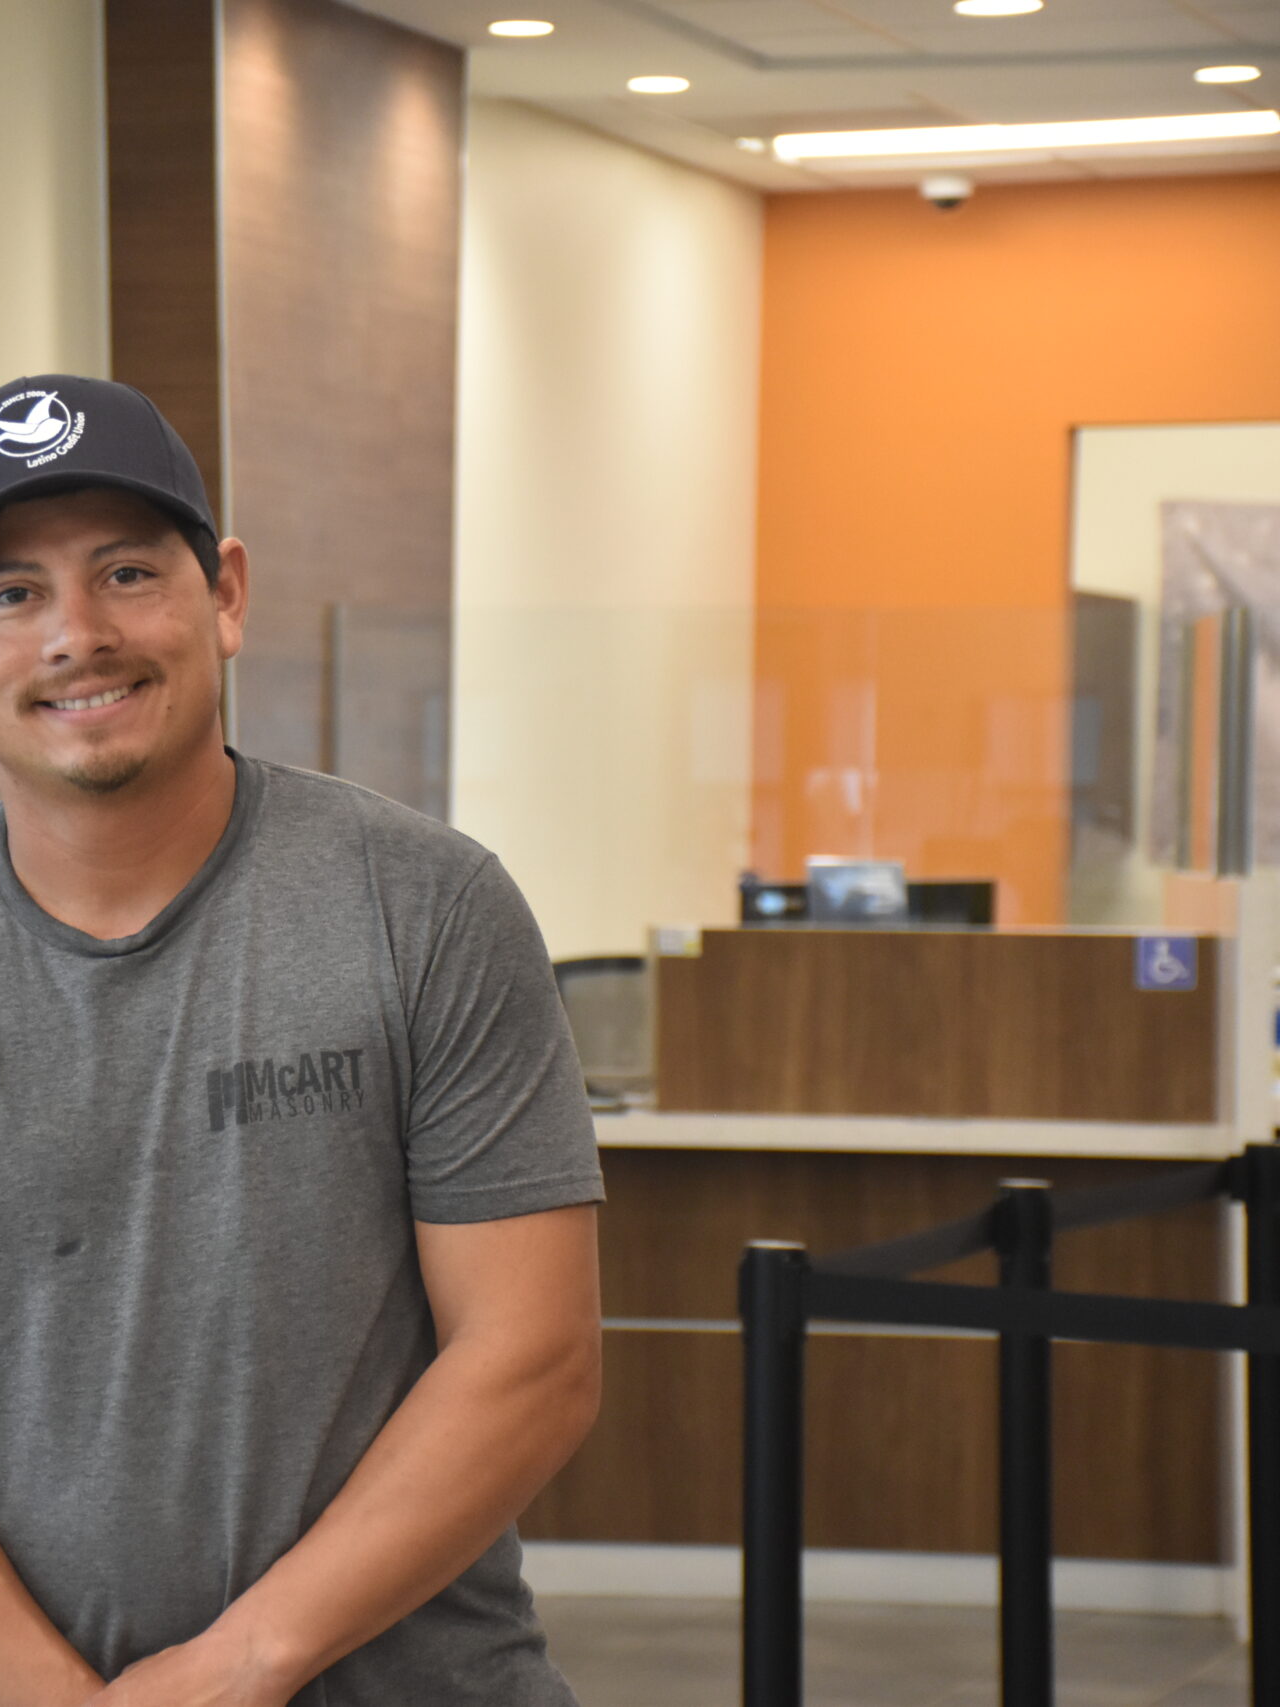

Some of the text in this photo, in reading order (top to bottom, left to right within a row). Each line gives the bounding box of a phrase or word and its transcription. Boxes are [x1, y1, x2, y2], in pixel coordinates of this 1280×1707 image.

[26, 452, 58, 469] Latino
[245, 1049, 363, 1102] McART
[247, 1089, 366, 1123] MASONRY
